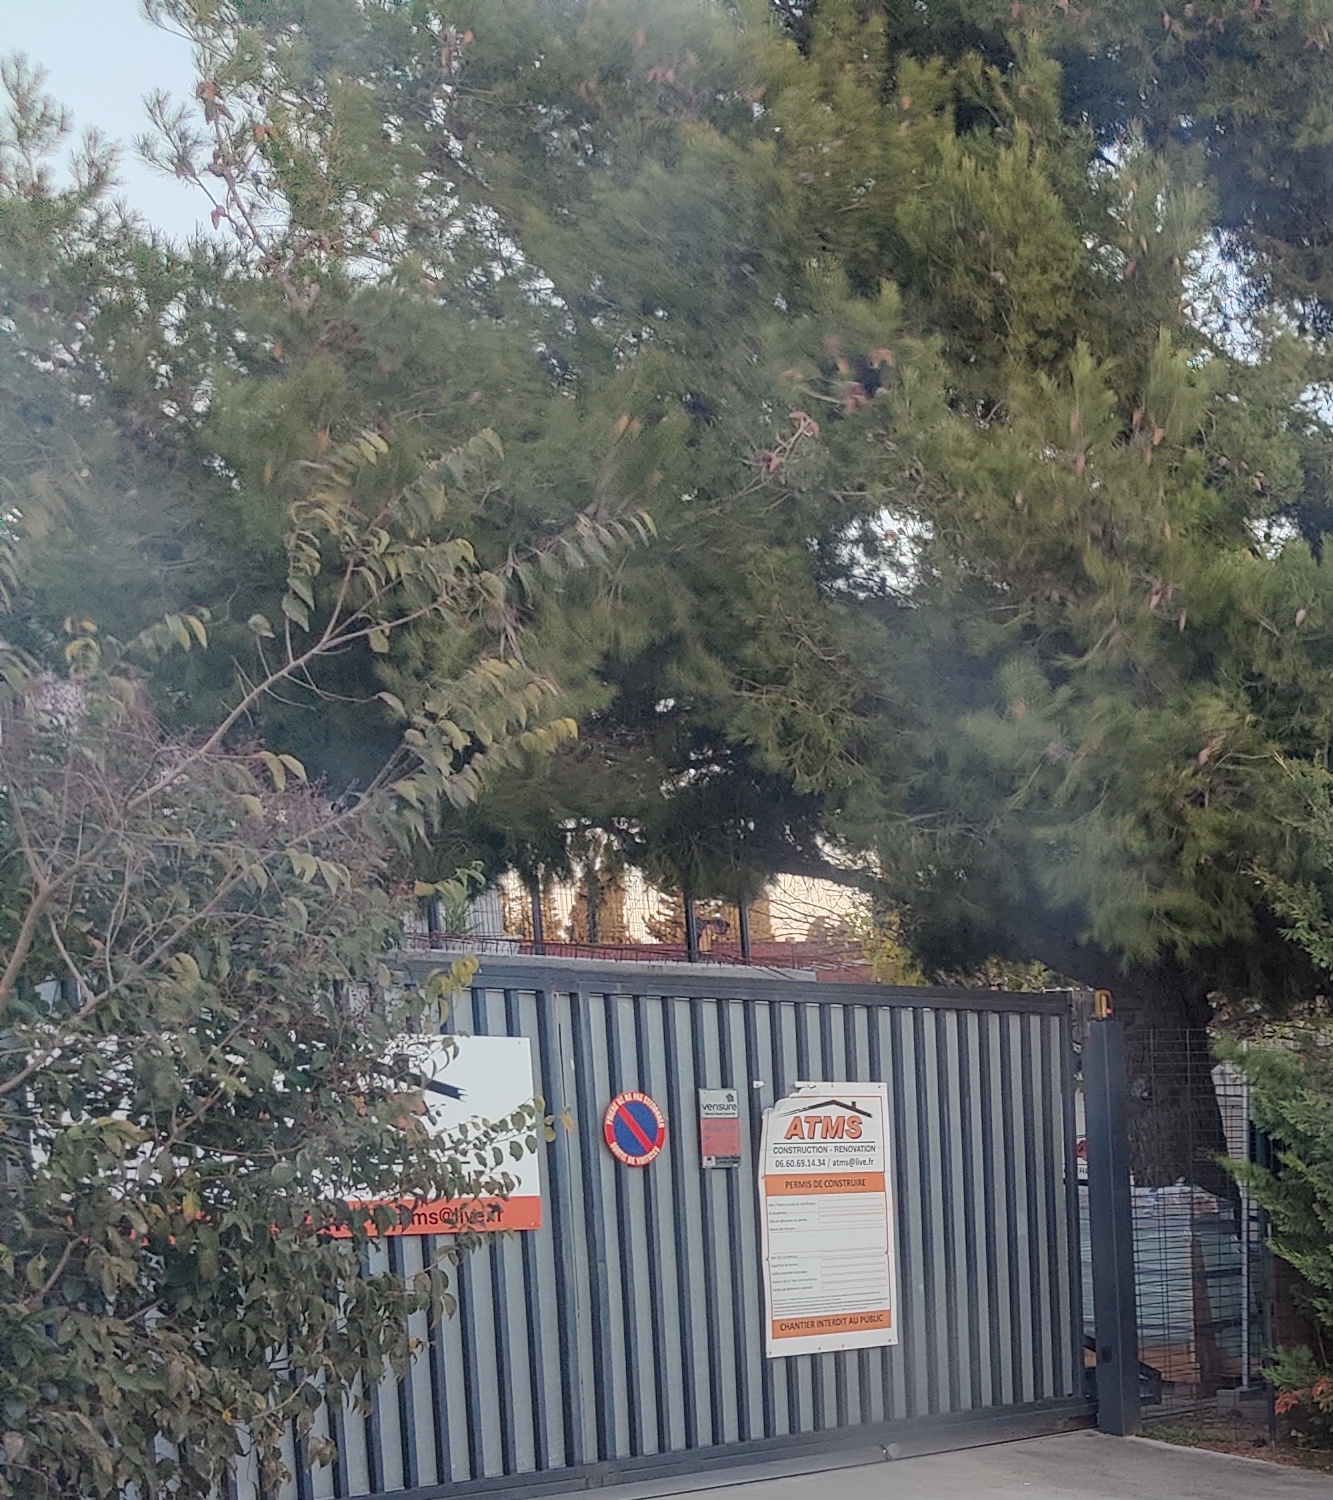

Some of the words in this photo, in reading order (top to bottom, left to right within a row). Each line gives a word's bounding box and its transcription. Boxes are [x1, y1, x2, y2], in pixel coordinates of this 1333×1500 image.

[784, 1115, 863, 1140] ATMS
[773, 1146, 828, 1154] CONSTRUCTION
[834, 1145, 876, 1153] RENOVATION
[775, 1158, 826, 1168] 06.60.69.14.34
[832, 1158, 874, 1167] atms@live.fr
[785, 1180, 813, 1189] PERMIS
[814, 1180, 823, 1188] DE
[824, 1179, 866, 1188] CONSTRUIRE
[780, 1320, 815, 1331] CHANTIER
[816, 1317, 847, 1328] INTERDIT
[848, 1316, 859, 1325] AU
[860, 1314, 883, 1324] PUBLIC
